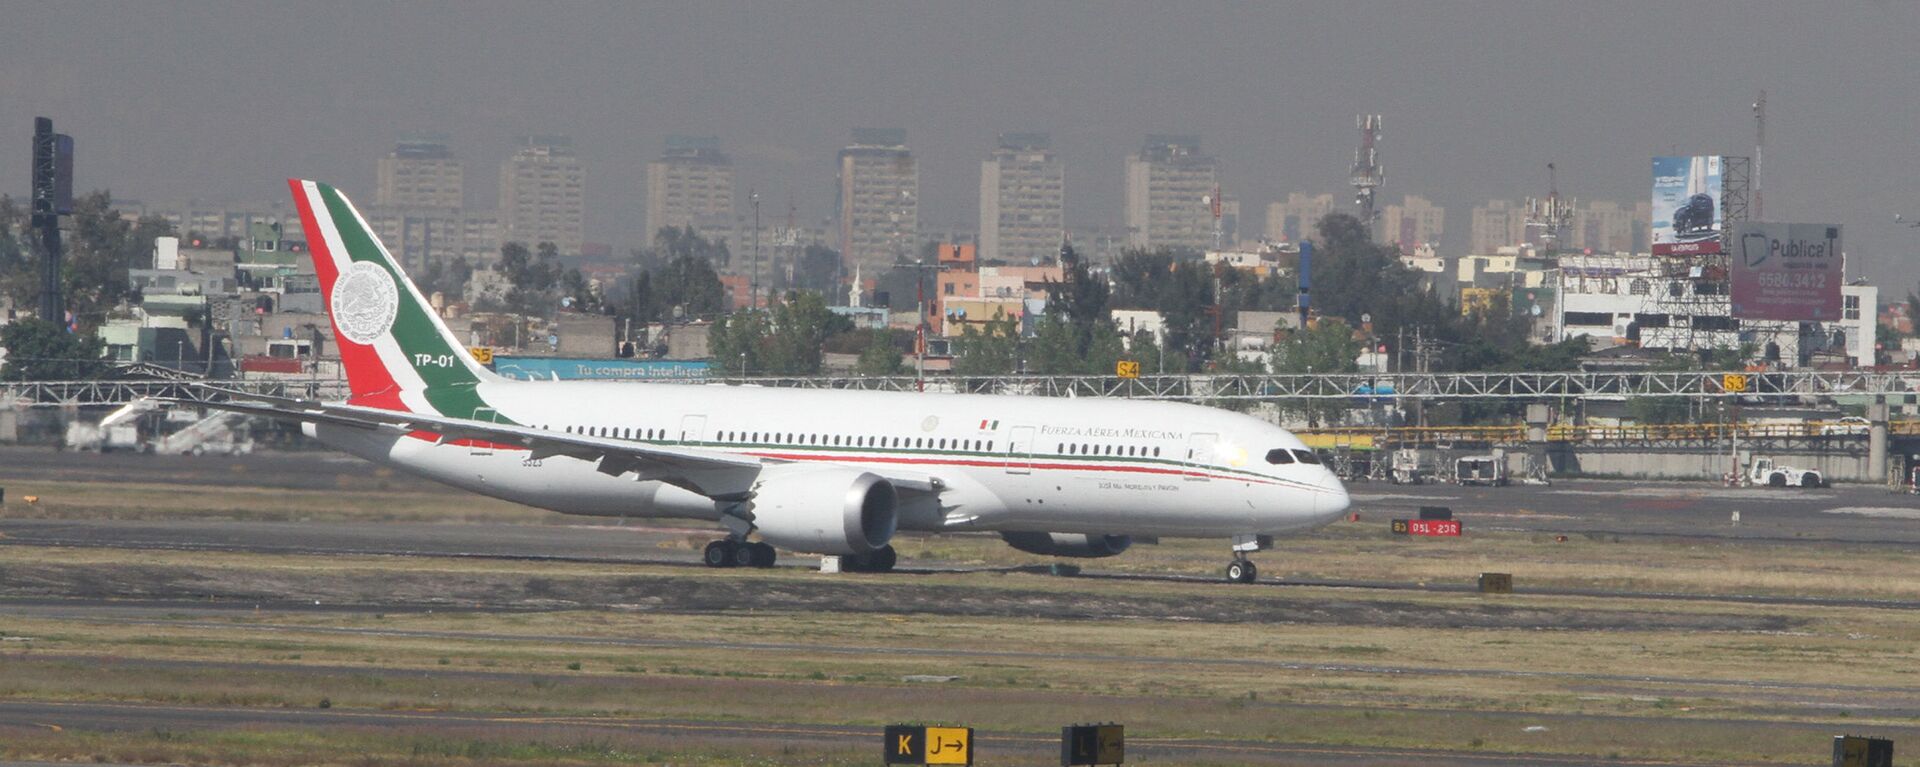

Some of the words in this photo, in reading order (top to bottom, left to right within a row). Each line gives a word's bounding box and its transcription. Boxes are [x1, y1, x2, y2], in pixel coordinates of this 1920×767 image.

[414, 353, 455, 368] TP-01
[471, 347, 491, 362] S5
[577, 364, 592, 376] Tu
[595, 366, 645, 377] compra
[1119, 363, 1137, 376] S4
[1726, 376, 1744, 389] S3
[1040, 424, 1081, 436] FUERZA
[1122, 428, 1184, 440] MEXICANA
[898, 734, 912, 756] K
[930, 735, 942, 755] J
